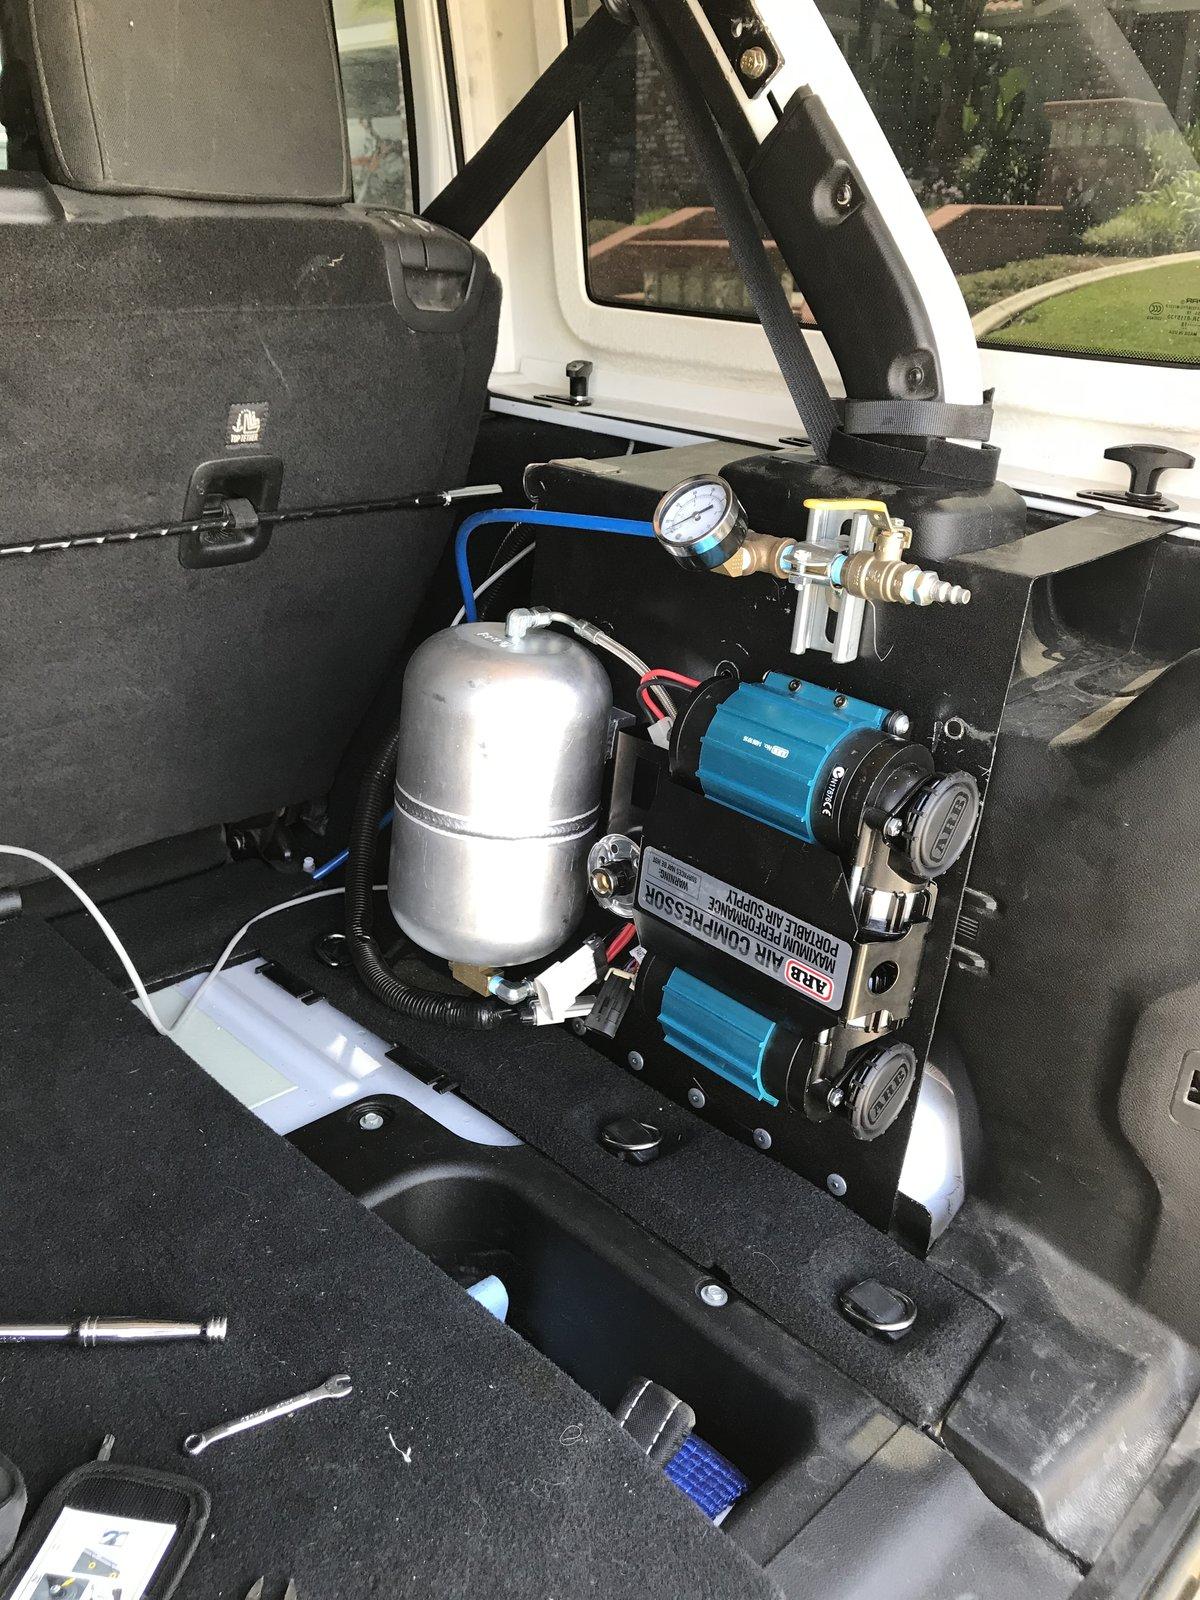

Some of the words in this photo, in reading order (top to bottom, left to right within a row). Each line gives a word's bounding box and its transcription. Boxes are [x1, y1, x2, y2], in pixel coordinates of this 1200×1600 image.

[934, 799, 965, 855] ARB
[645, 885, 750, 956] COMPRESSOR
[708, 896, 782, 947] PERFORMANCE
[726, 889, 765, 917] SUPPLY
[765, 909, 788, 928] AIR
[783, 919, 839, 957] PORTABLE
[783, 937, 836, 974] MAXIMUM
[755, 943, 784, 973] AIR
[791, 966, 828, 995] ARB
[874, 1070, 905, 1117] ARB
